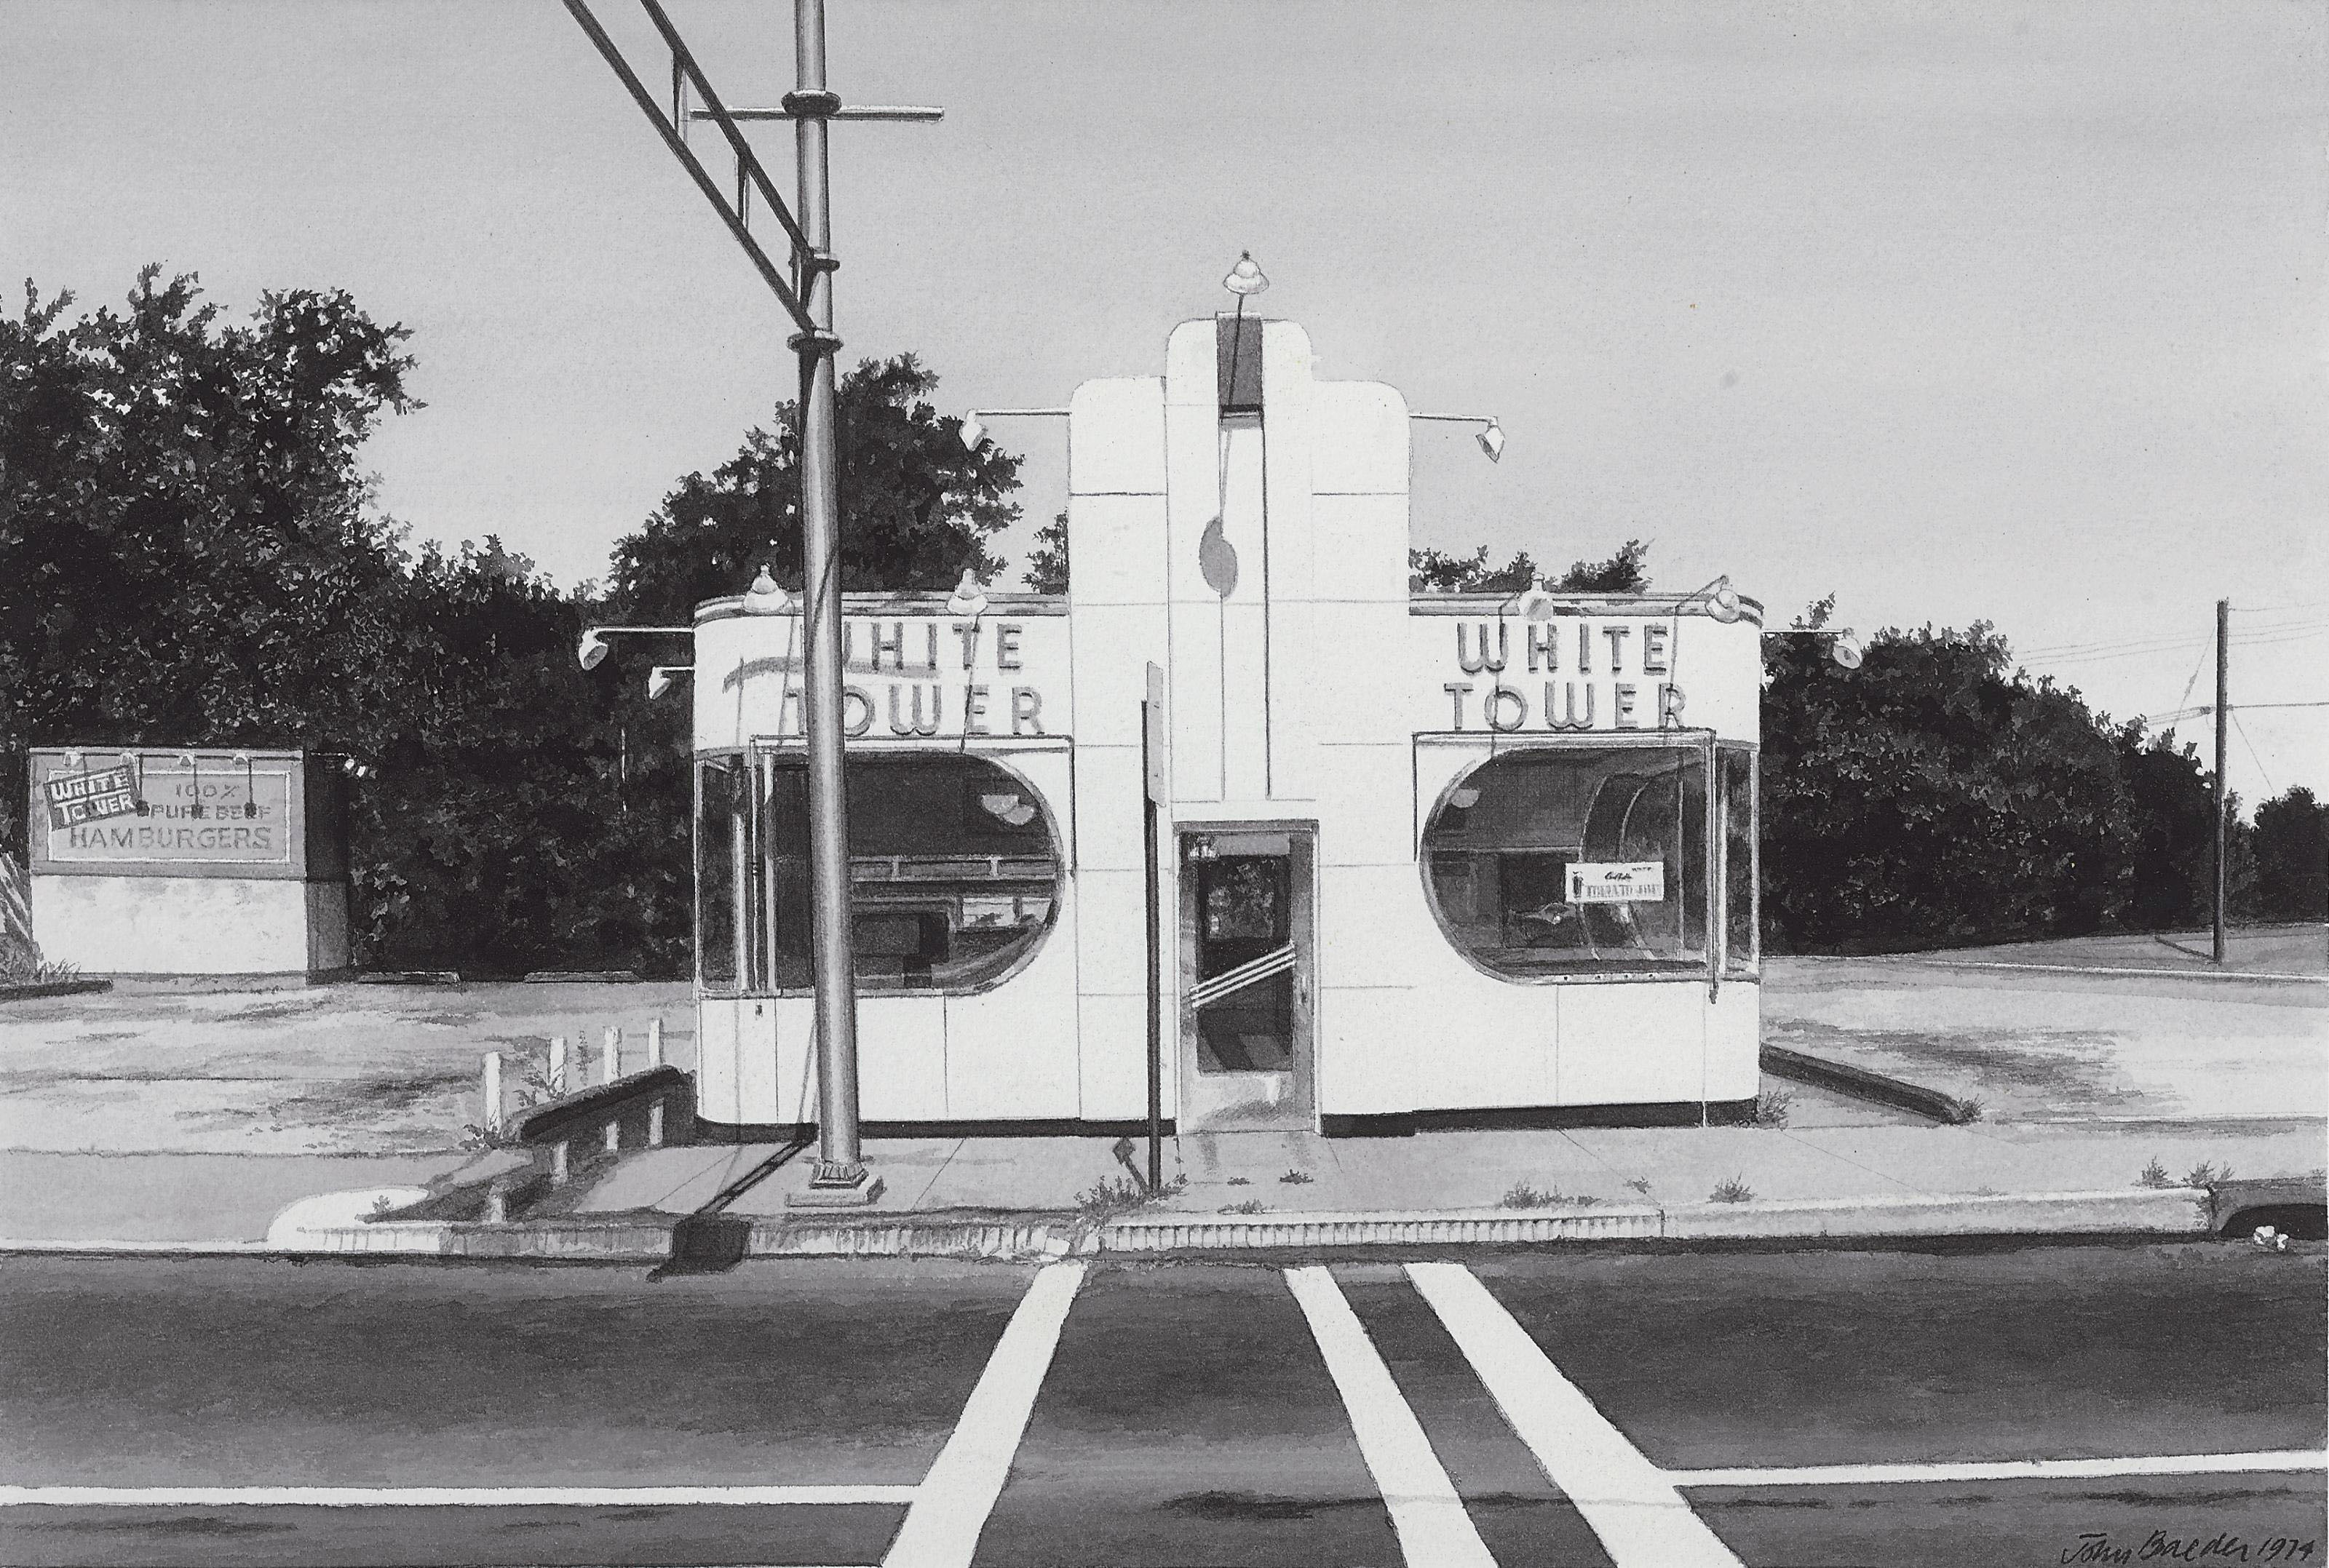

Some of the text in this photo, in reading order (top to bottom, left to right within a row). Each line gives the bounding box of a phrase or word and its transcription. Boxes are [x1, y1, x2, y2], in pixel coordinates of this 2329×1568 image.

[1457, 622, 1670, 676] WHITE
[1444, 682, 1687, 732] TOWER
[49, 769, 131, 801] WHITE
[175, 783, 240, 800] 100%
[216, 804, 271, 820] BEF
[69, 827, 272, 850] HAMBURGERS
[2061, 1529, 2315, 1564] John Baeder 1974
